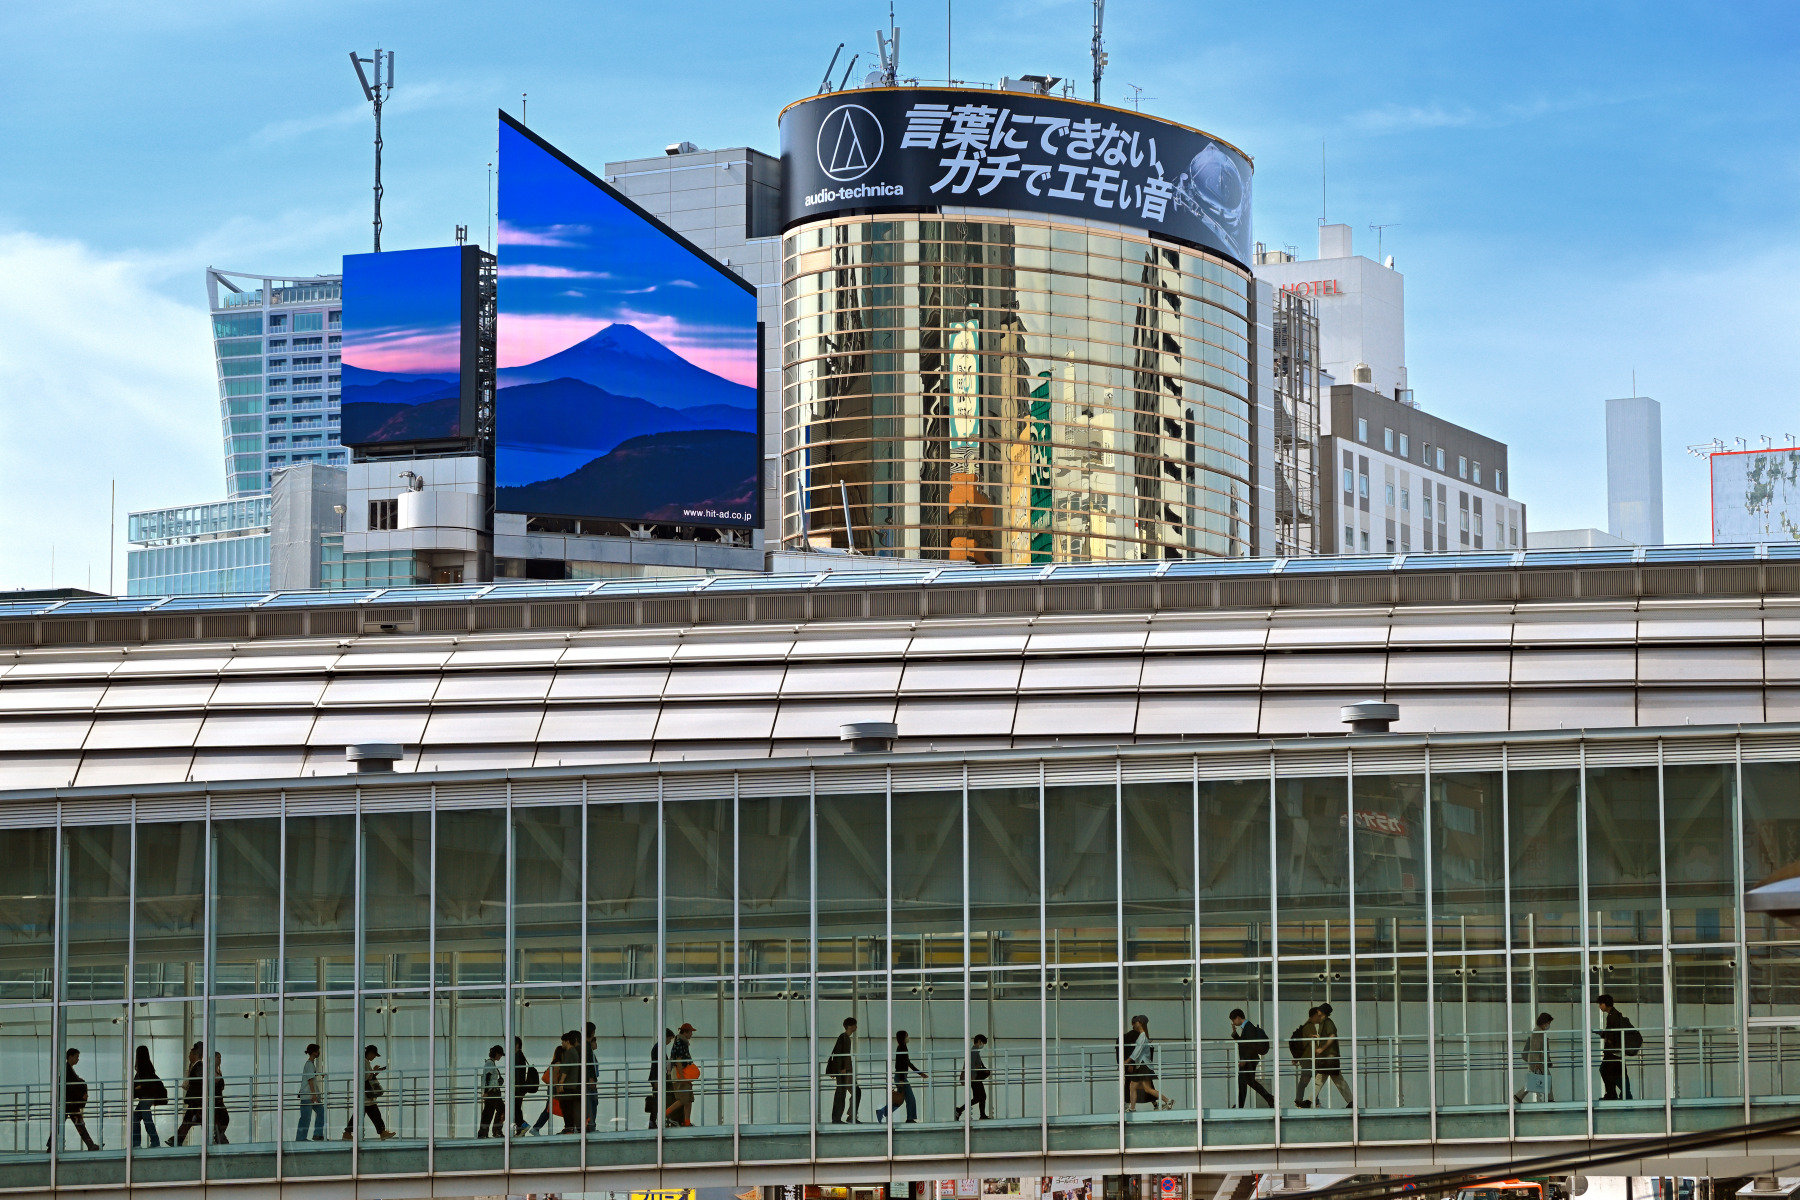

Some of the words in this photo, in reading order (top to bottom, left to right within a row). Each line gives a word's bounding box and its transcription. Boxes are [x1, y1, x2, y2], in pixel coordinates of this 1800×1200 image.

[900, 103, 1165, 177] 言葉にできない、
[804, 181, 905, 207] audio-technica
[1282, 280, 1343, 298] HOTEL
[683, 509, 752, 521] www.hit-ad.co.jp
